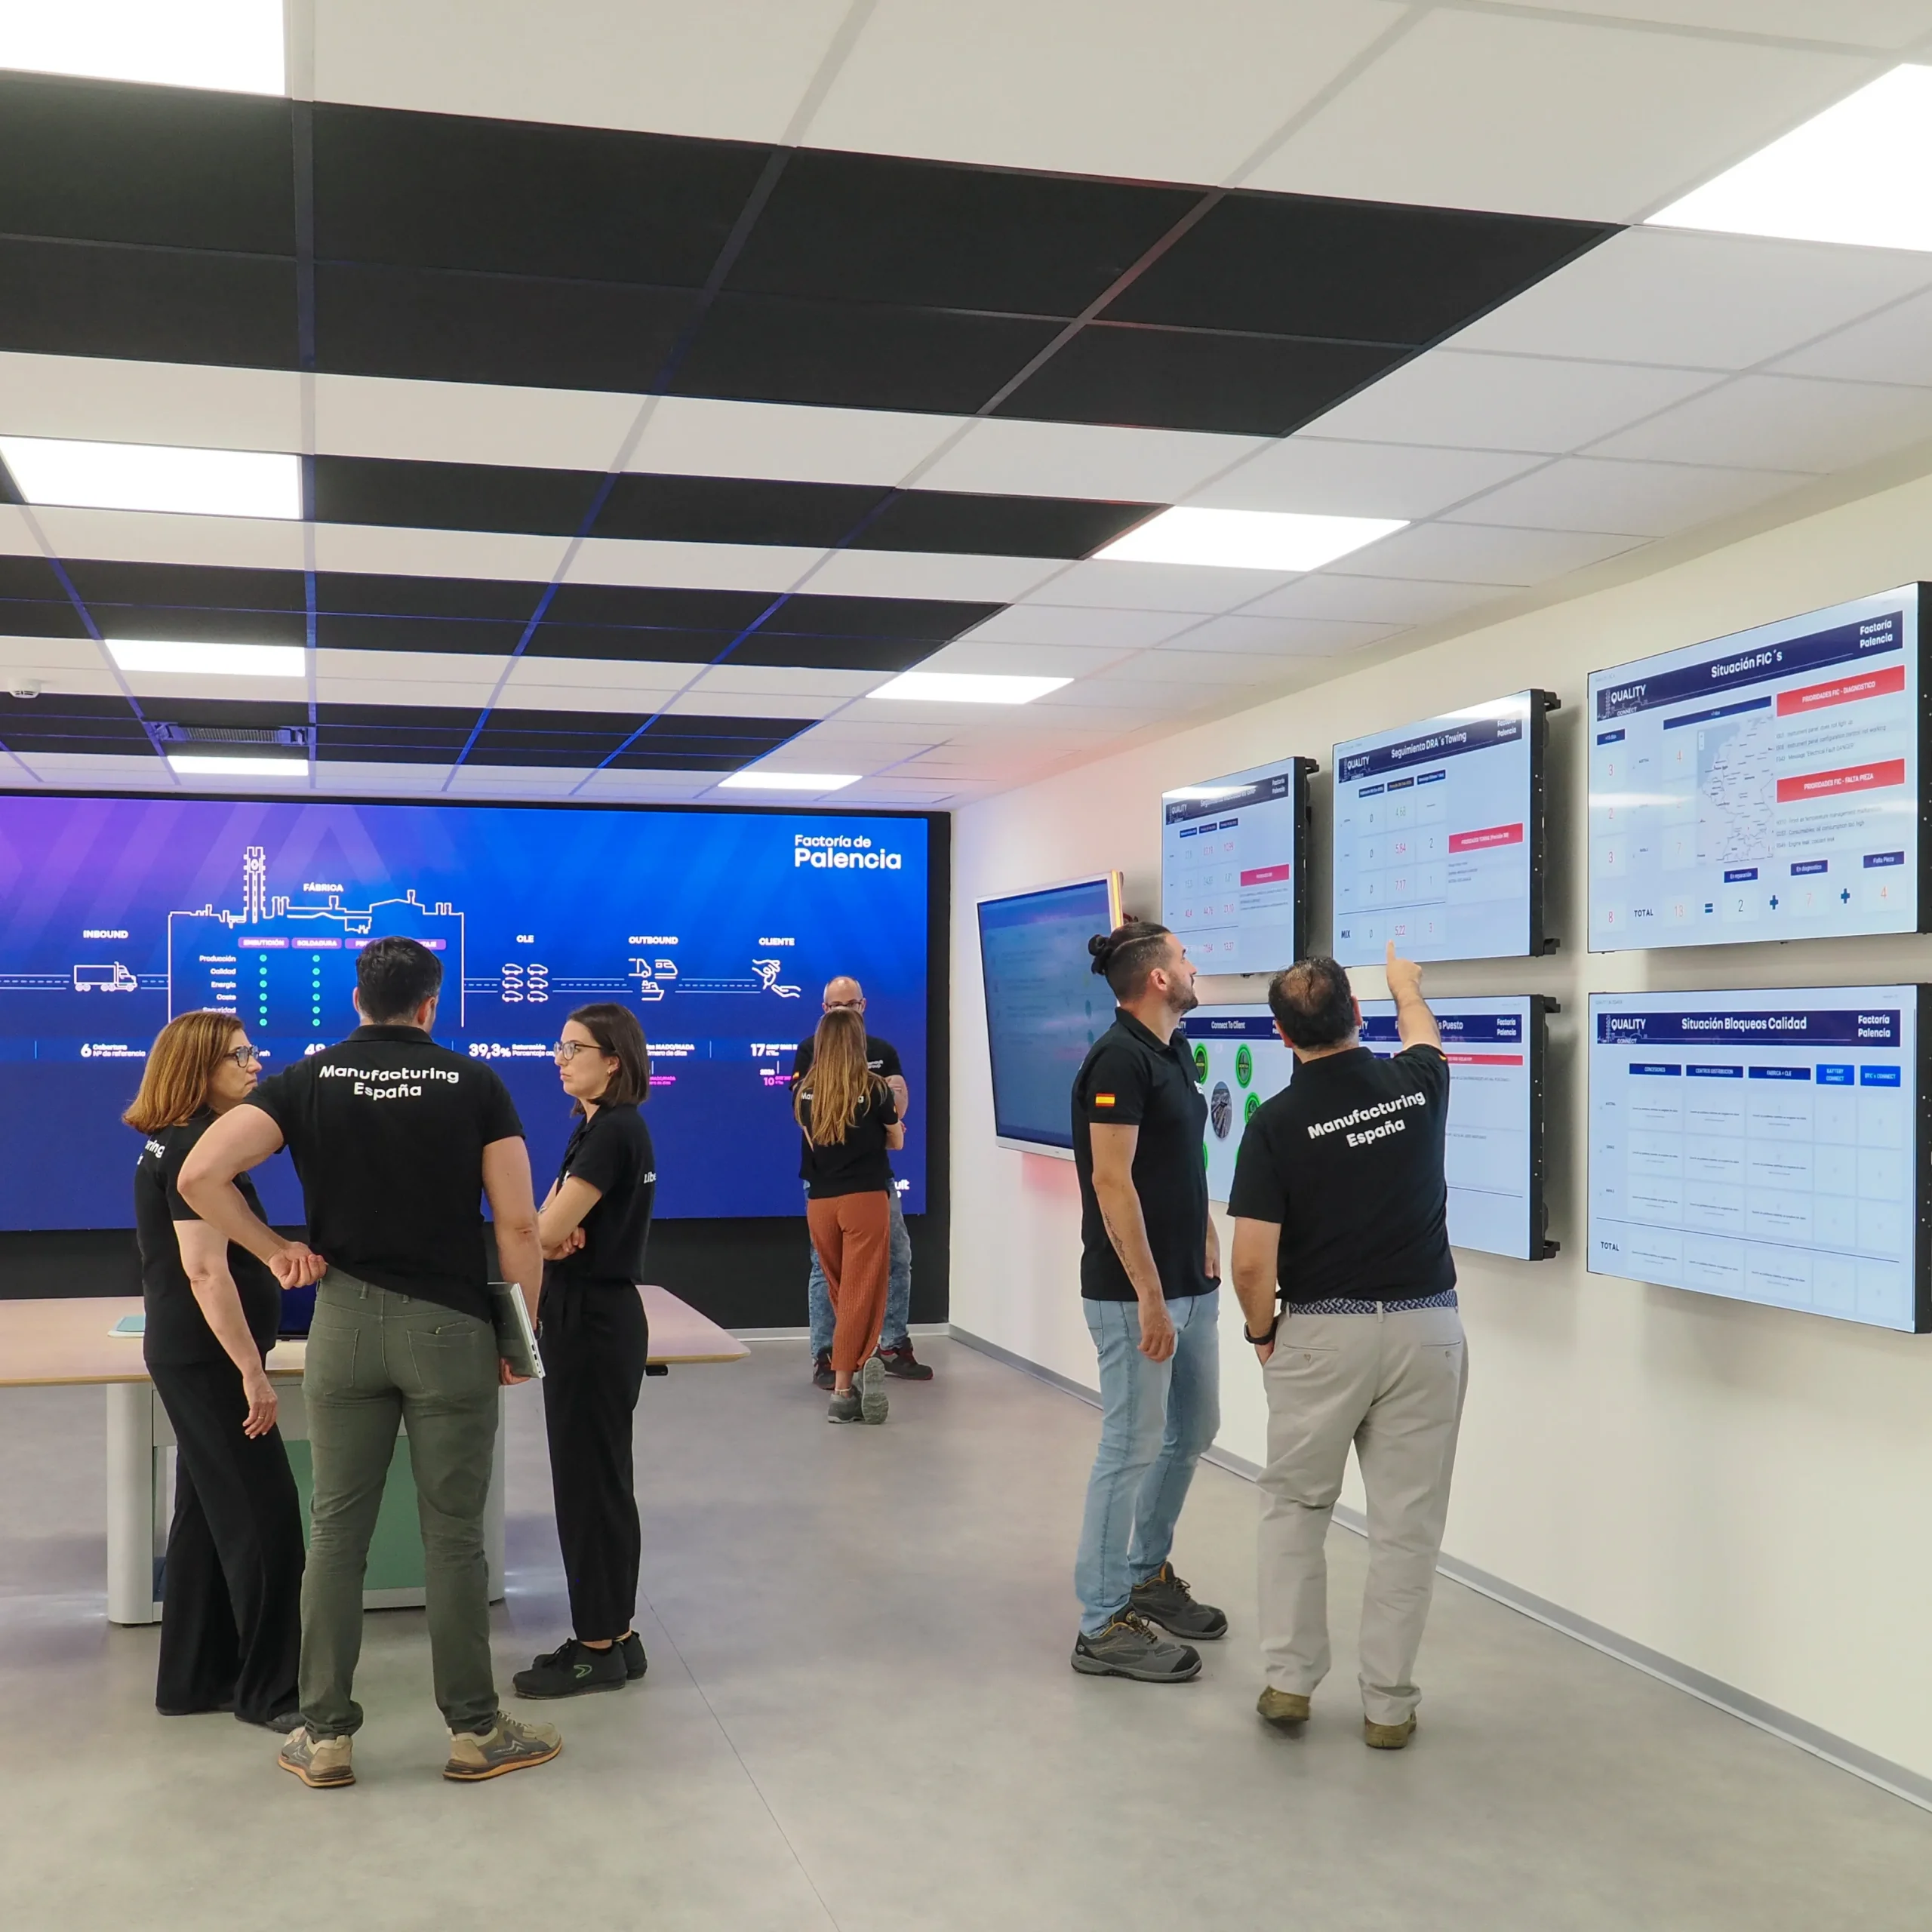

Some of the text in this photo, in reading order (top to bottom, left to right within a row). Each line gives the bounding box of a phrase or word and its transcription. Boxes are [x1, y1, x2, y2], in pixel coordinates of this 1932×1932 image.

[1860, 620, 1892, 635] Factoría
[1860, 633, 1893, 649] Palencia
[1711, 657, 1755, 678] Situación
[1611, 684, 1647, 704] QUALITY
[1497, 727, 1517, 737] Palencia
[1391, 743, 1426, 759] Seguimiento
[1445, 731, 1467, 746] Towing
[1347, 755, 1370, 770] QUALITY
[1608, 764, 1614, 776] 3
[1171, 804, 1187, 814] QUALITY
[795, 834, 872, 848] Factoría de
[795, 848, 902, 869] Palencia
[1608, 851, 1614, 863] 3
[303, 882, 344, 892] FÁBRICA
[1608, 911, 1614, 923] 8
[1634, 909, 1654, 917] TOTAL
[1738, 899, 1744, 912] 2
[1881, 886, 1887, 900] 4
[83, 930, 128, 939] INBOUND
[628, 936, 678, 945] OUTBOUND
[758, 937, 795, 946] CLIENTE
[1211, 1020, 1245, 1029] Connect To Client
[1442, 1020, 1463, 1030] Puesto
[1611, 1018, 1646, 1031] QUALITY
[1681, 1017, 1807, 1032] Situación Bloqueos Calidad
[1858, 1014, 1890, 1024] Factoría
[1497, 1028, 1516, 1036] Palencia
[1858, 1027, 1890, 1038] Palencia
[80, 1043, 92, 1057] 6
[469, 1043, 512, 1059] 39,3%
[750, 1043, 766, 1057] 17
[318, 1065, 460, 1084] Manufacturing
[764, 1076, 775, 1086] 10
[354, 1082, 422, 1100] España
[1307, 1091, 1426, 1140] Manufacturing
[1346, 1118, 1406, 1148] España
[1601, 1241, 1620, 1251] TOTAL
